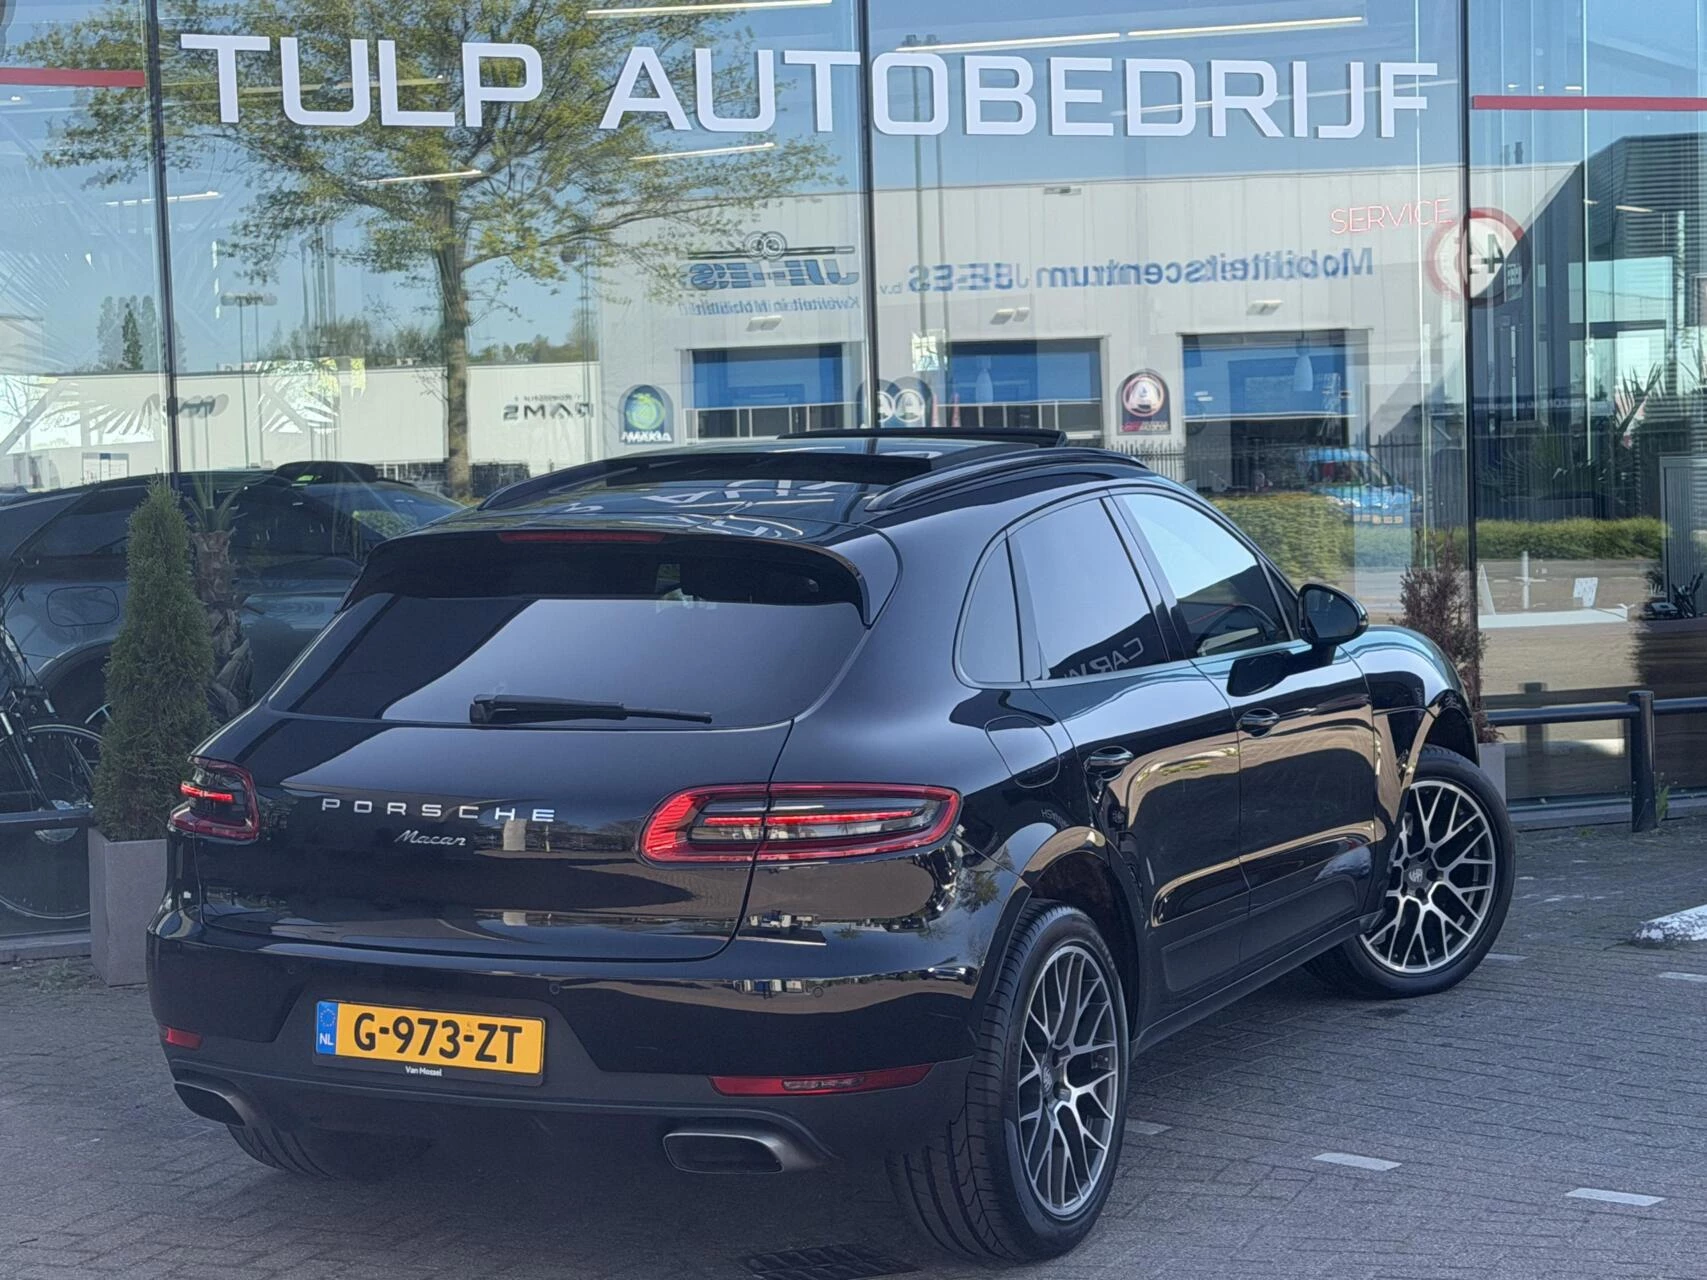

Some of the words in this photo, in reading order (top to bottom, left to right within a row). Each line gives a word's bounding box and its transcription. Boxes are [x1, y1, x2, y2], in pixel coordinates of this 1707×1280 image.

[180, 33, 543, 127] TULP
[598, 46, 1438, 138] AUTOBEDRIJF
[1329, 198, 1453, 234] SERVICE
[321, 798, 556, 823] PORSCHE
[394, 828, 468, 848] Macan
[319, 1032, 334, 1046] NL
[353, 1012, 523, 1064] G-973-ZT
